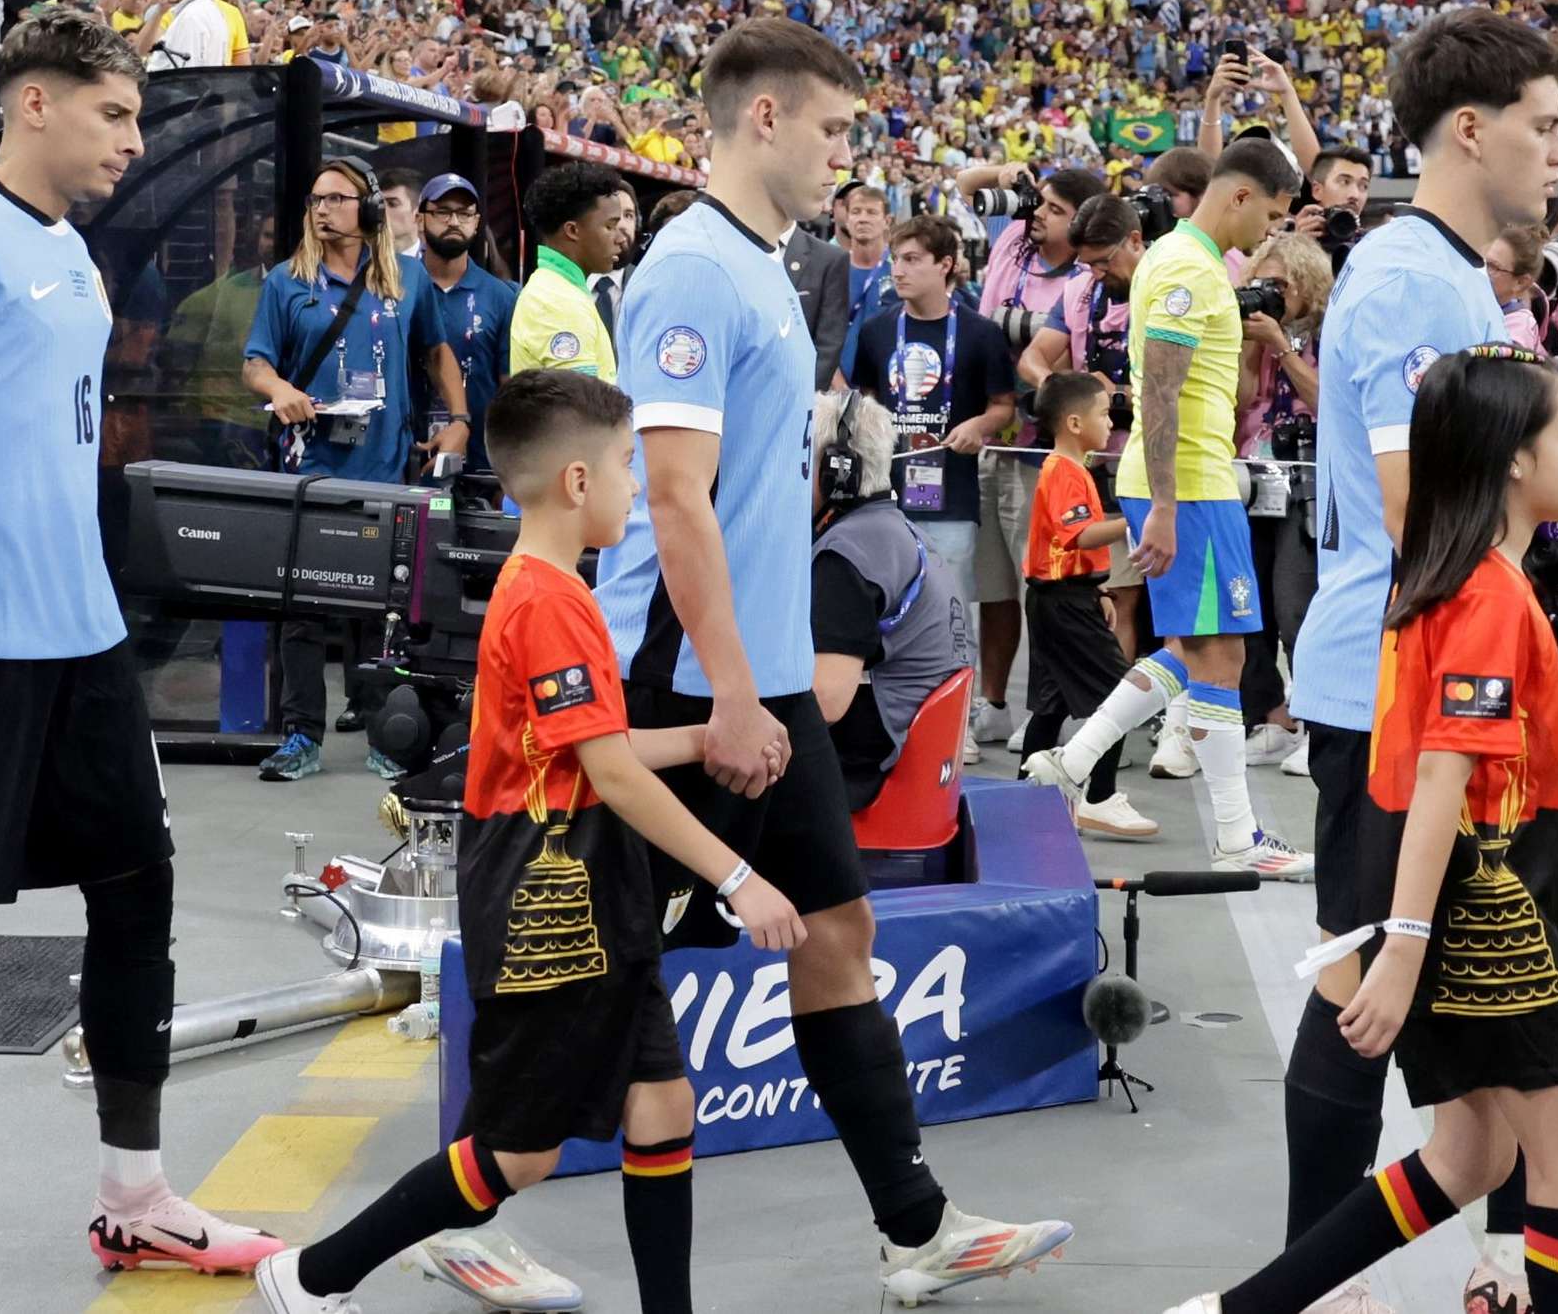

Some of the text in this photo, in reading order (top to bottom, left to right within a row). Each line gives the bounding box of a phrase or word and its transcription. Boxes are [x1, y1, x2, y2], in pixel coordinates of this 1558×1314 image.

[74, 374, 95, 446] 16
[178, 527, 221, 540] Canon
[448, 551, 481, 561] SONY
[301, 569, 354, 586] DIGISUPER
[356, 574, 375, 586] 122
